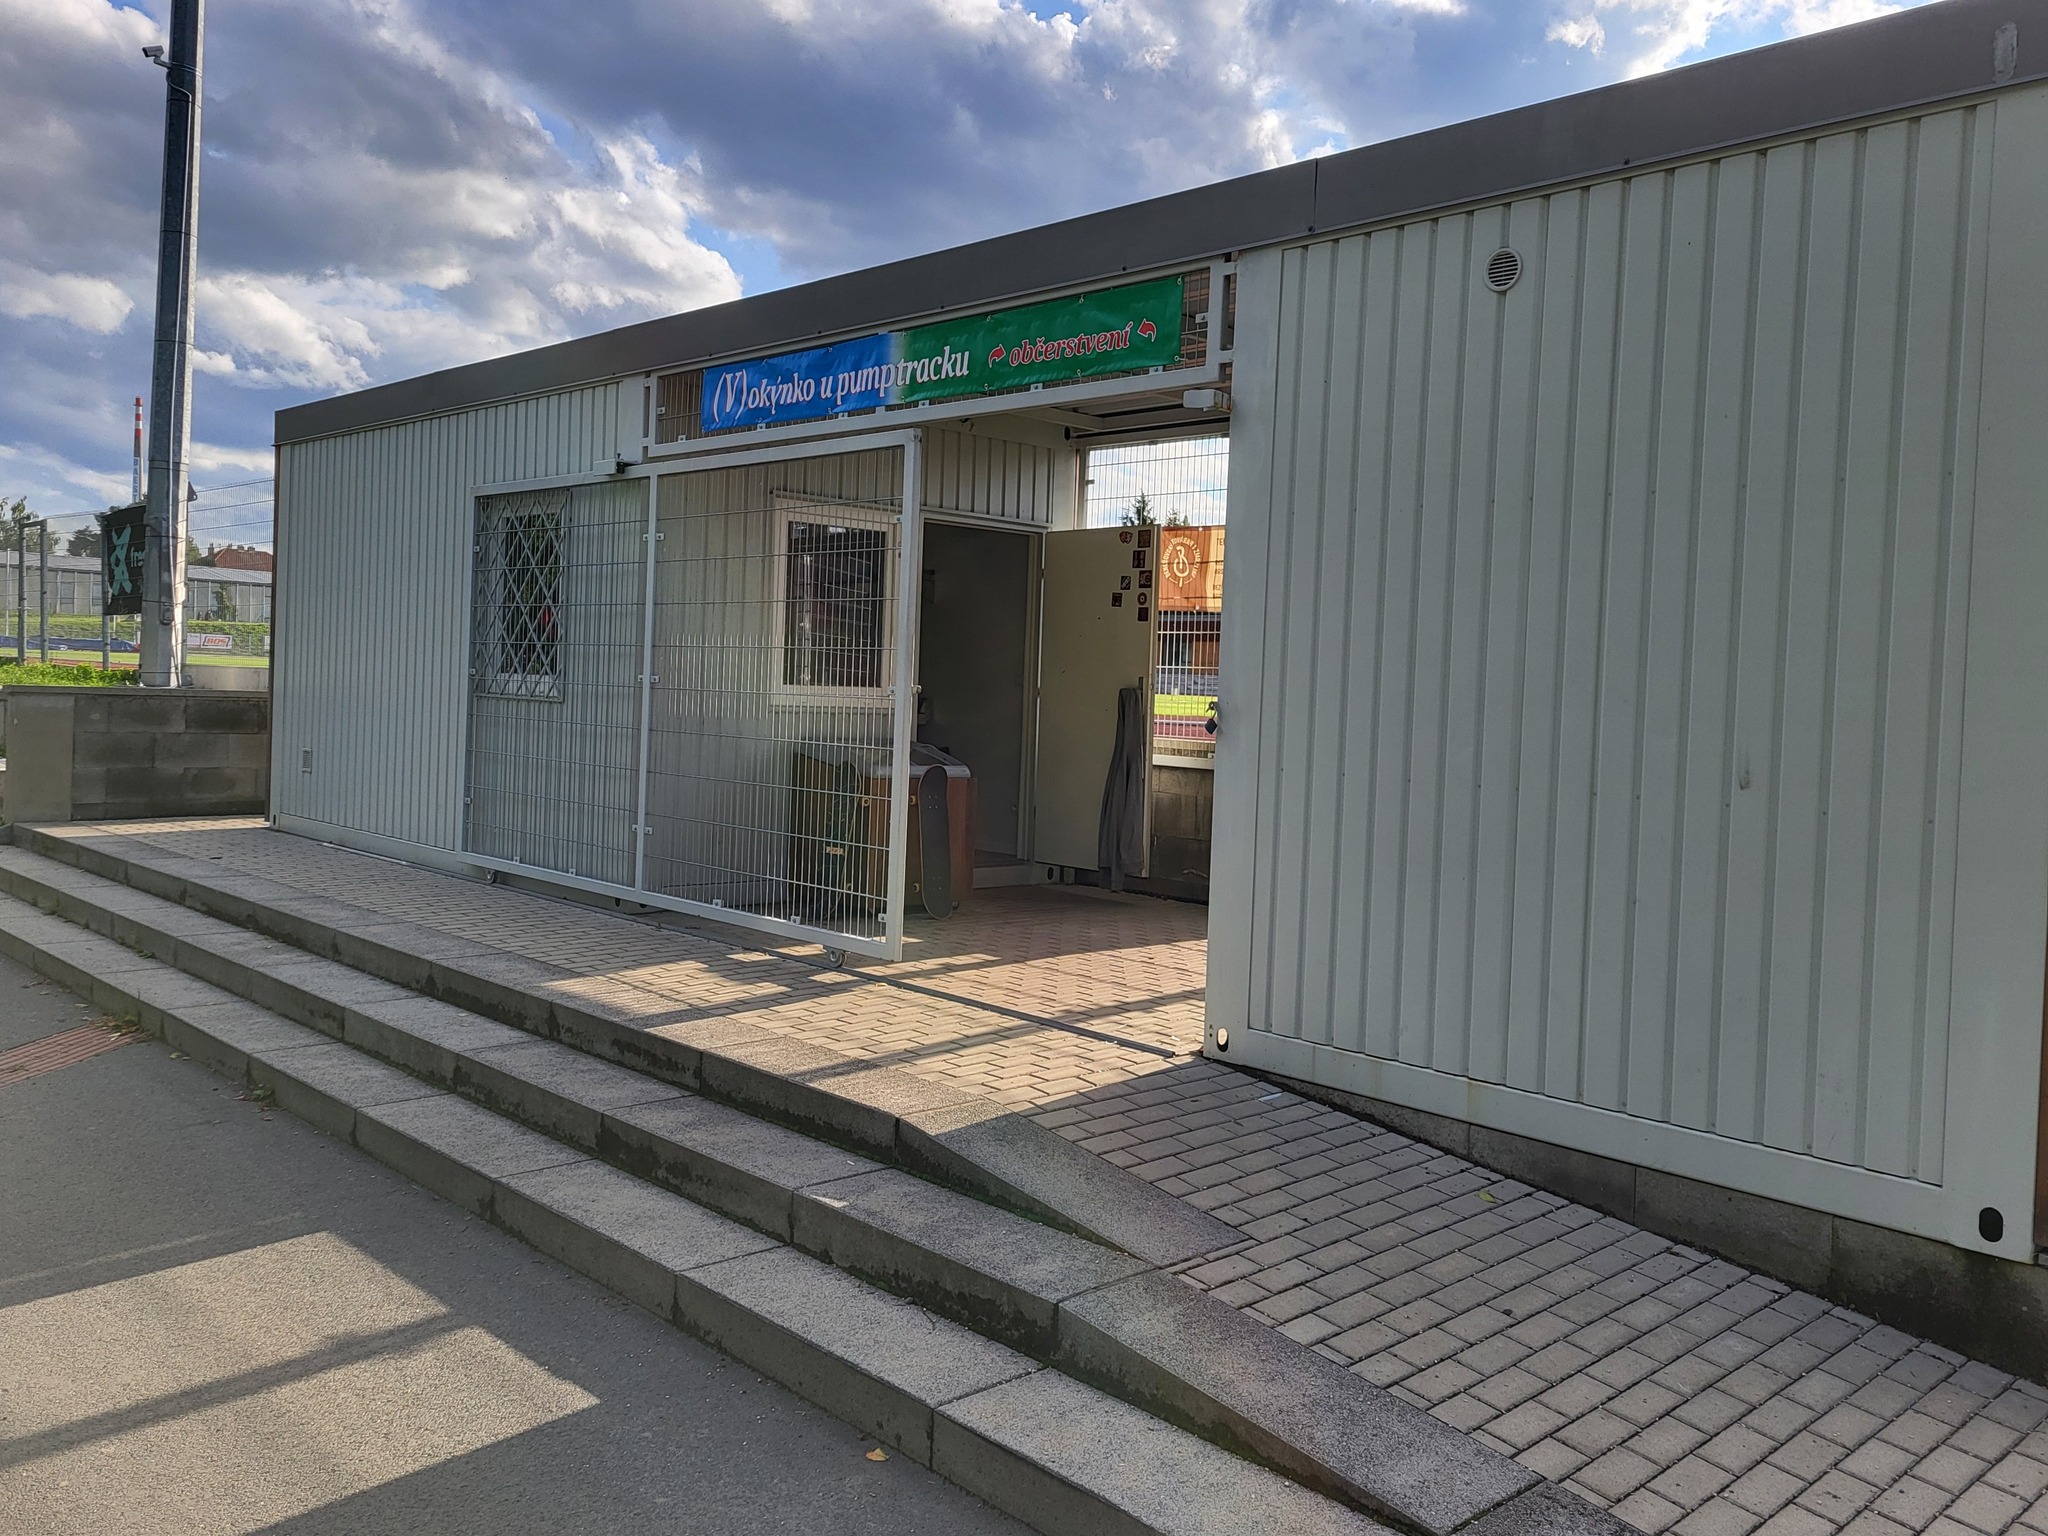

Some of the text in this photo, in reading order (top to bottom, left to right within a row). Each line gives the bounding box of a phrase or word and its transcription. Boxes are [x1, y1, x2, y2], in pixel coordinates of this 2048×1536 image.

[1009, 321, 1134, 367] občerstvení
[713, 346, 970, 423] (V)okýnko u pumptracku
